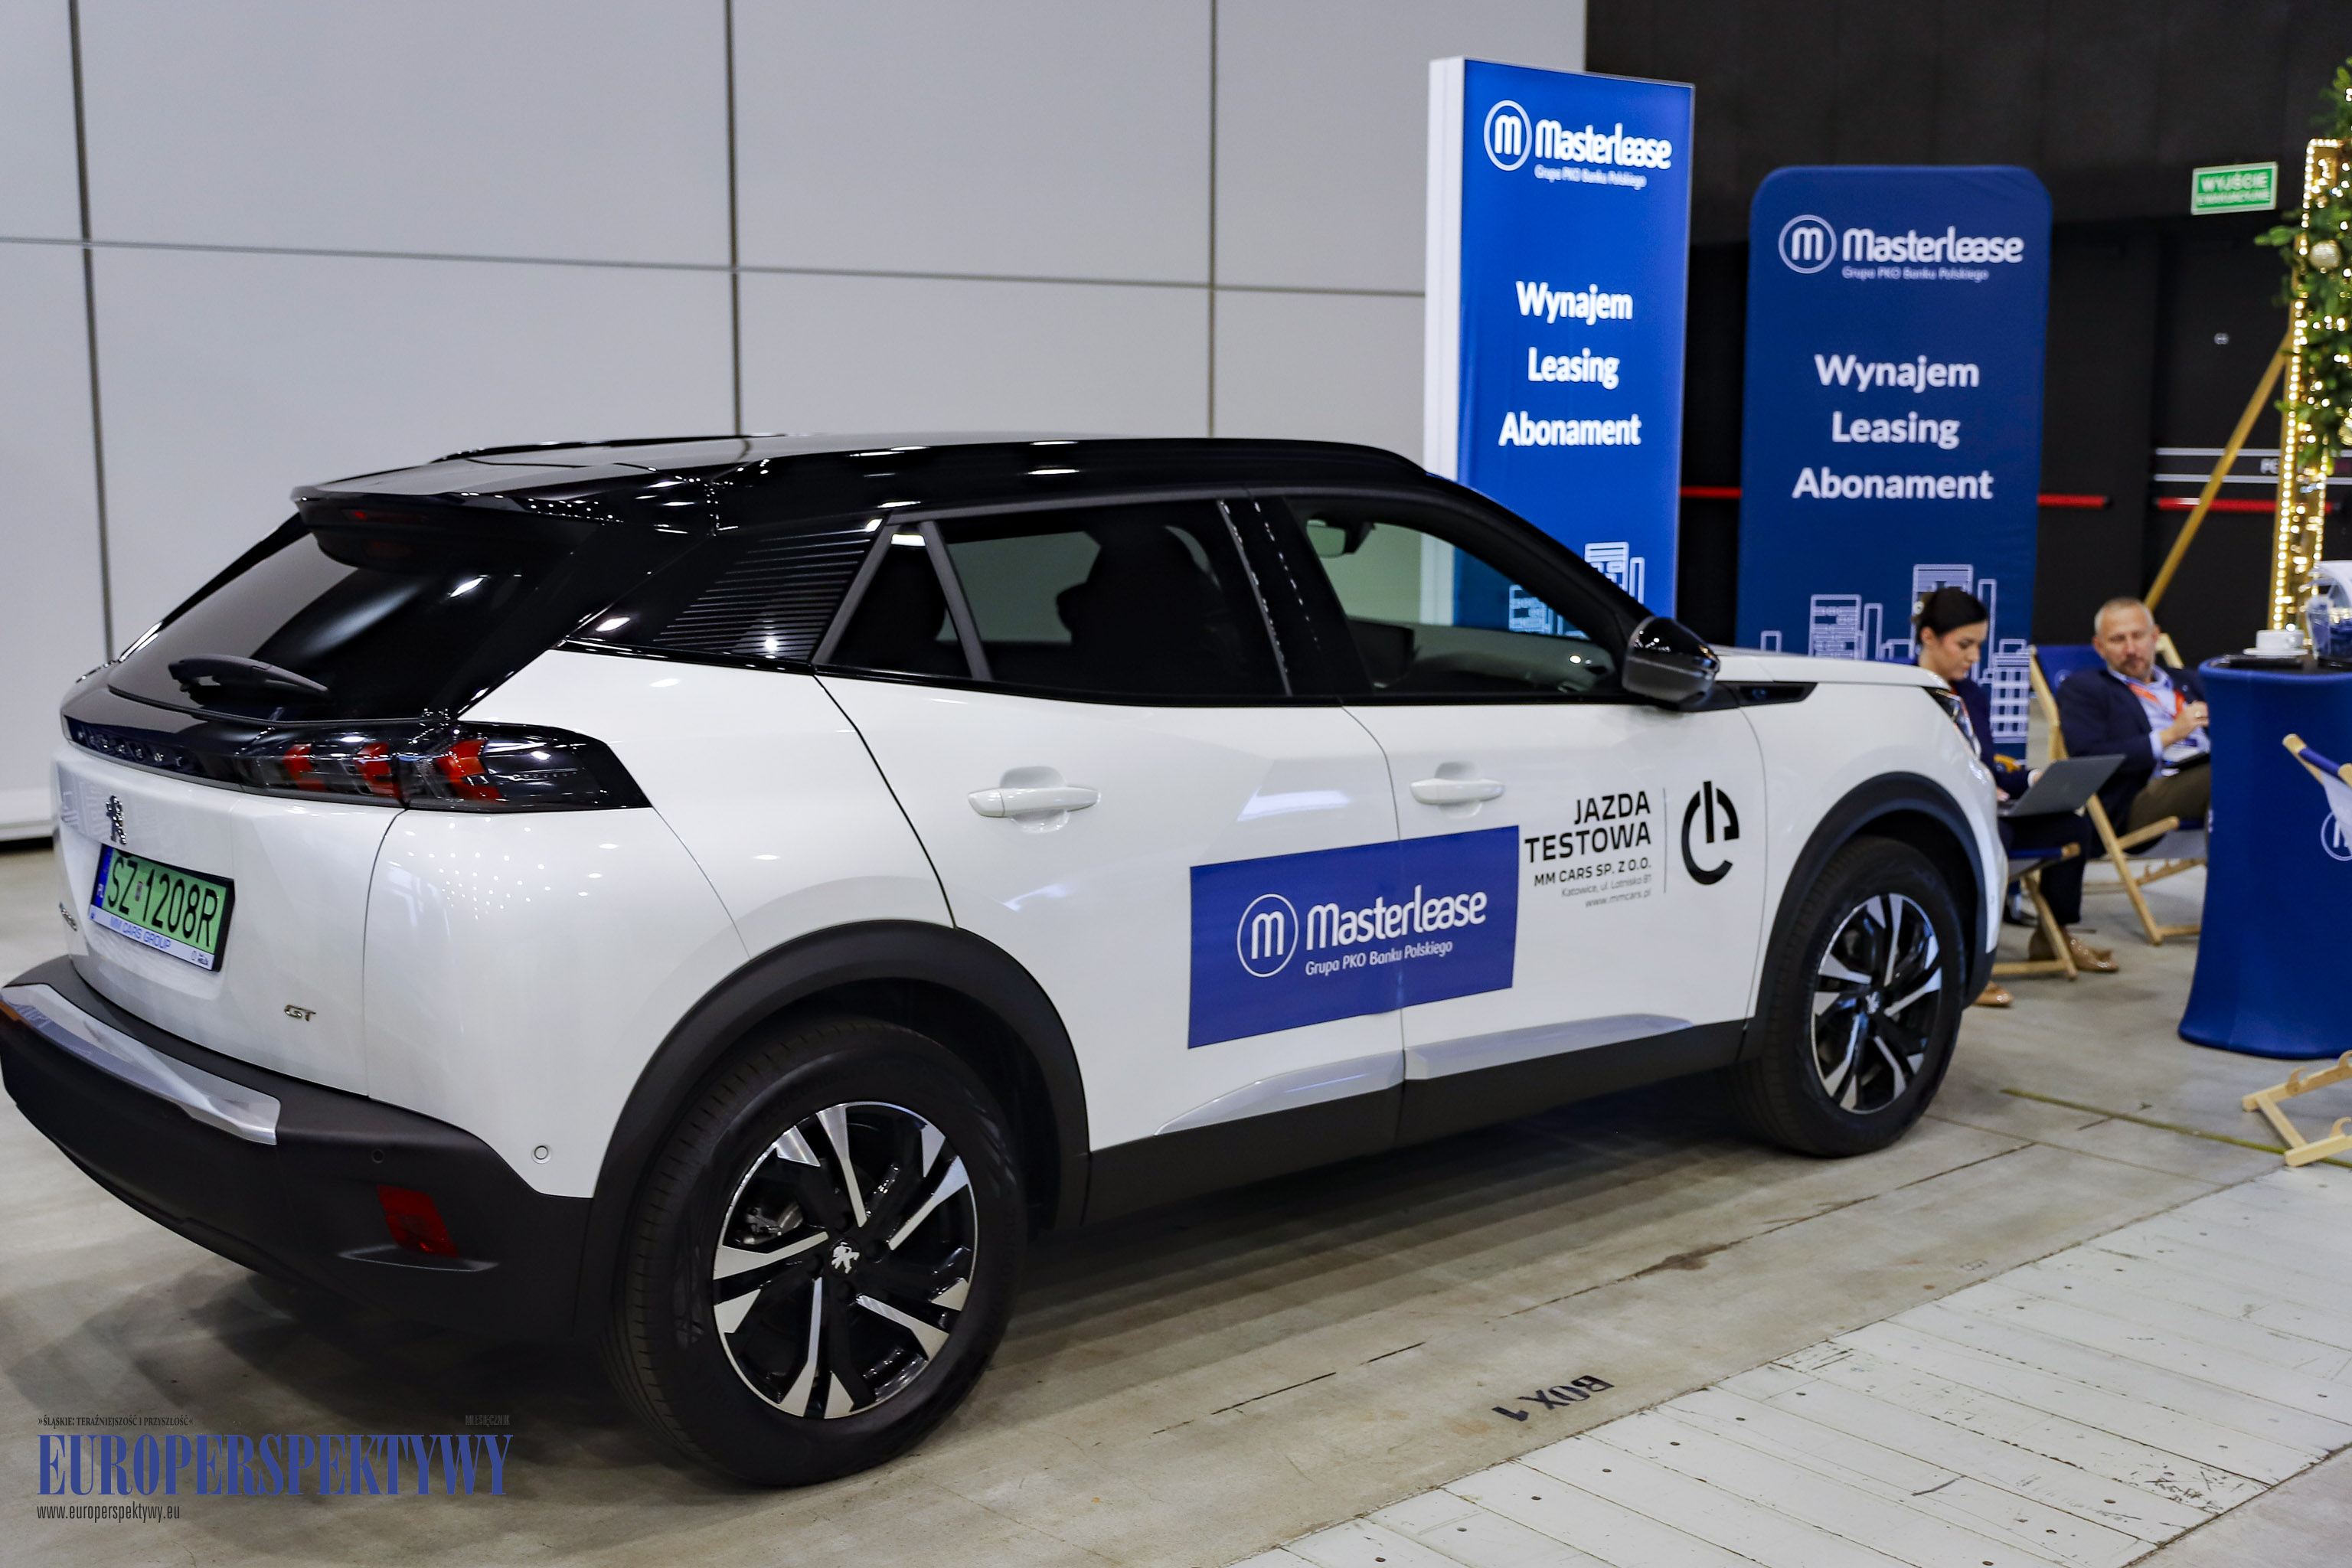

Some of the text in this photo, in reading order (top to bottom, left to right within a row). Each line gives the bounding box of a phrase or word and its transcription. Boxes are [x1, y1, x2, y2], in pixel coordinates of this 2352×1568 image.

[1535, 119, 1673, 170] Masterlease
[1843, 225, 2025, 264] Masterlease
[1841, 265, 1990, 283] Grupa PKO Banku Polskiego
[1515, 280, 1633, 326] Wynajem
[1528, 346, 1620, 390] Leasing
[1814, 354, 1980, 394] Wynajem
[1498, 410, 1642, 446] Abonament
[1832, 410, 1961, 450] Leasing
[1792, 466, 1994, 500] Abonament
[1573, 791, 1651, 825] JAZDA
[1524, 822, 1651, 863] TESTOWA
[1534, 857, 1651, 887] MM CARS SP. Z O.O.
[108, 856, 139, 915] SZ
[143, 868, 218, 947] 1208R
[1305, 884, 1488, 952] Masterlease
[122, 921, 142, 939] CARS
[143, 930, 172, 949] GROUP
[1305, 940, 1453, 977] Grupa PKO Banku Polskiego
[1491, 1375, 1615, 1423] BOX 1
